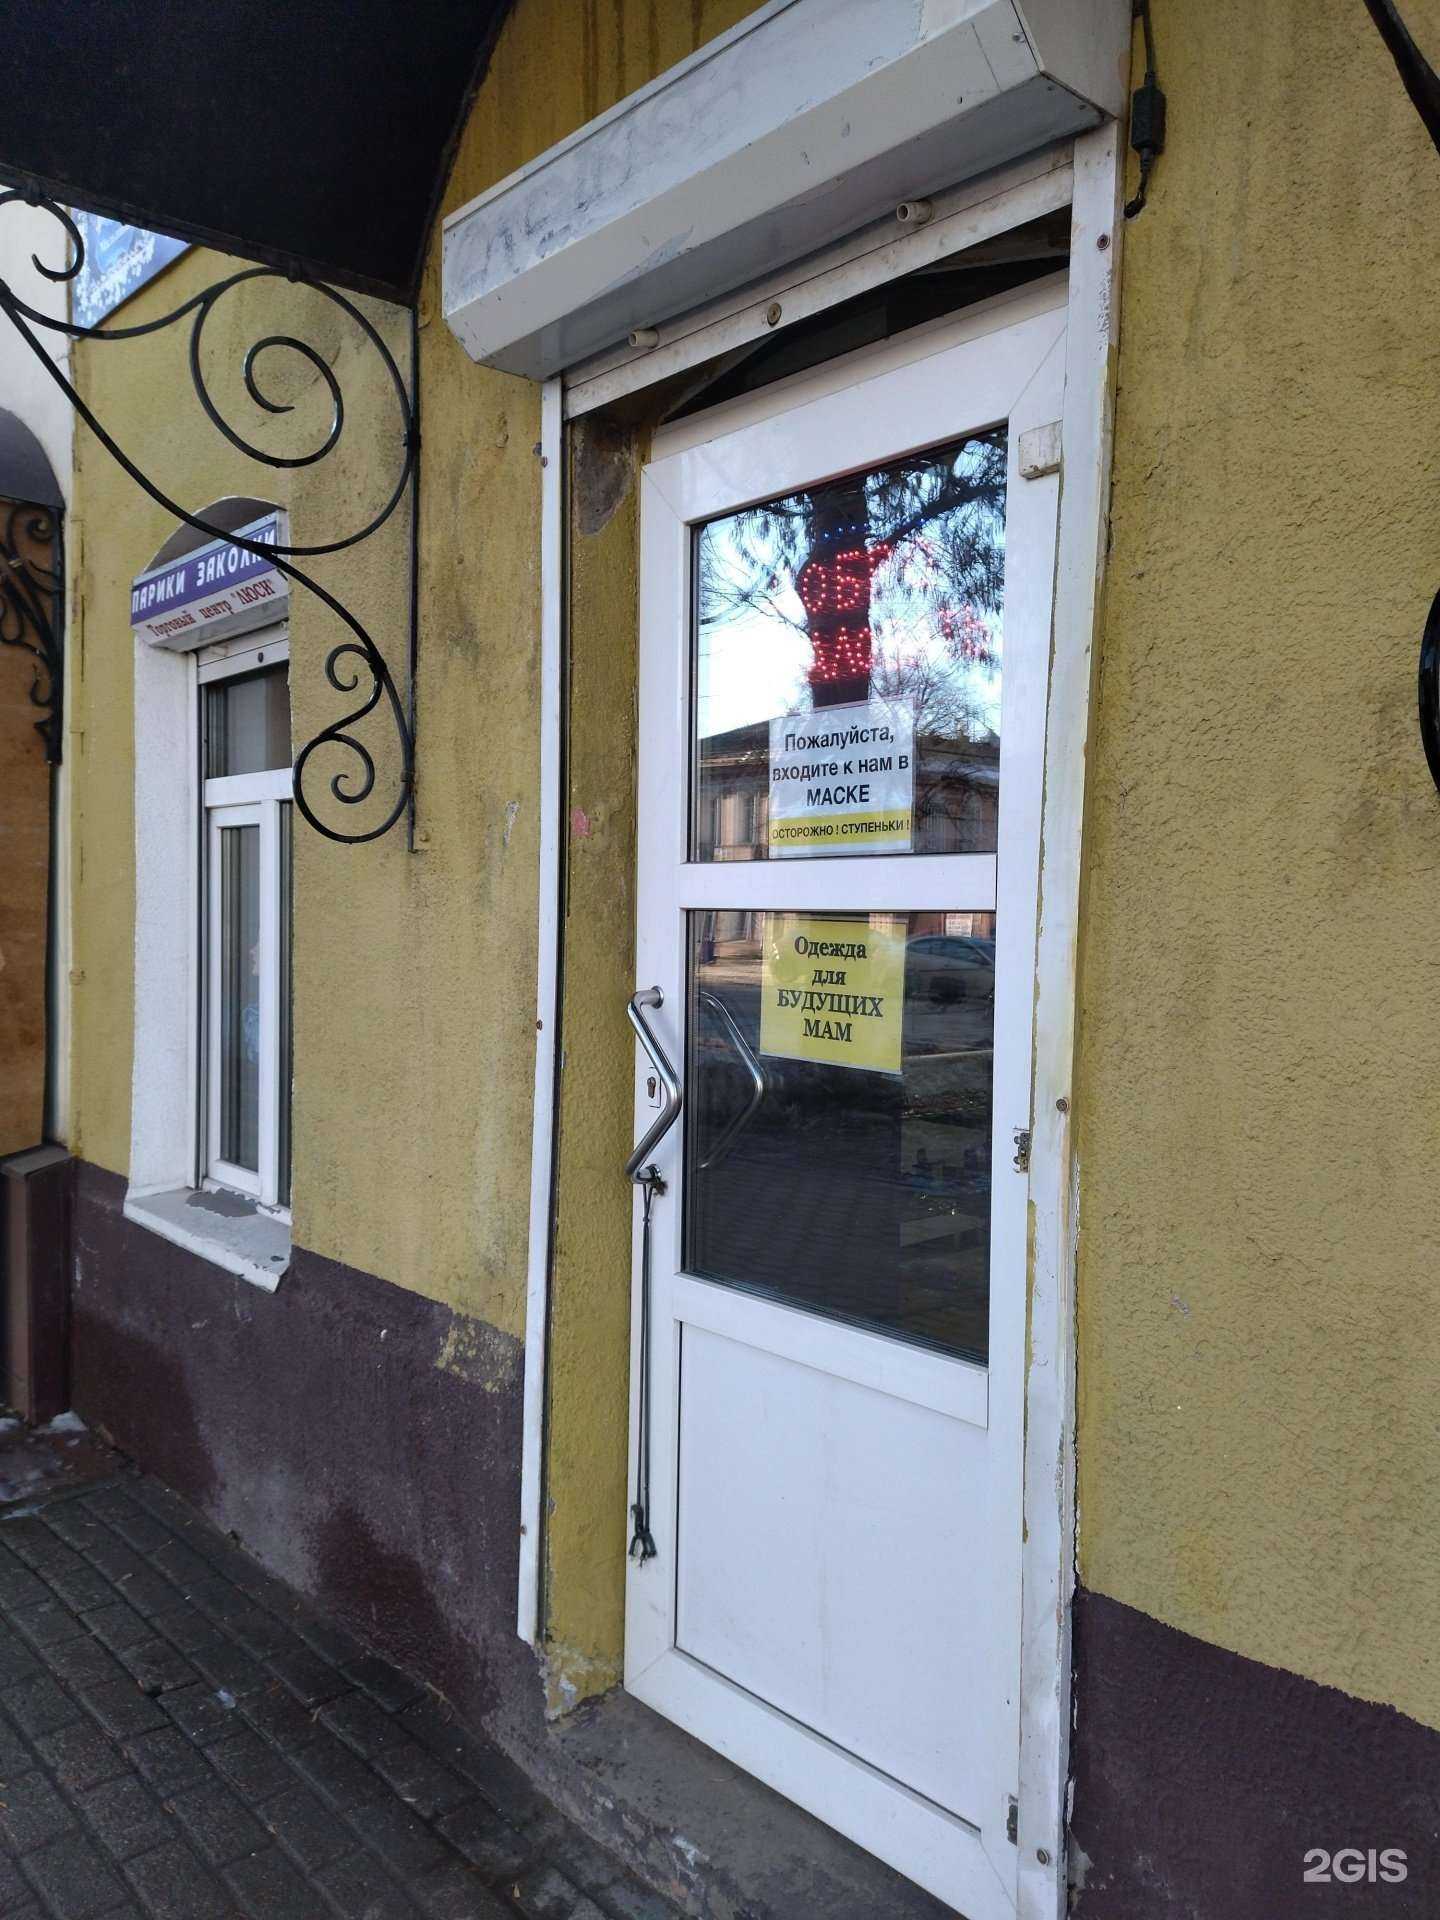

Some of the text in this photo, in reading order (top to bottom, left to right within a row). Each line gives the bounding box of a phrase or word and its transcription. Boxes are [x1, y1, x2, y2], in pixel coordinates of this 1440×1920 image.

[132, 570, 186, 614] ПАРИКИ
[146, 610, 197, 637] Торговый
[199, 600, 234, 615] центр
[785, 725, 894, 752] Пожалуйста,
[772, 761, 838, 782] входите
[843, 761, 853, 775] к
[858, 756, 893, 774] нам
[806, 784, 870, 807] МАСКЕ
[841, 820, 904, 834] СТУПЕНЬКИ
[794, 936, 867, 961] Одежда
[811, 969, 847, 987] для
[776, 988, 884, 1018] БУДУЩИХ
[803, 1018, 853, 1042] МАМ
